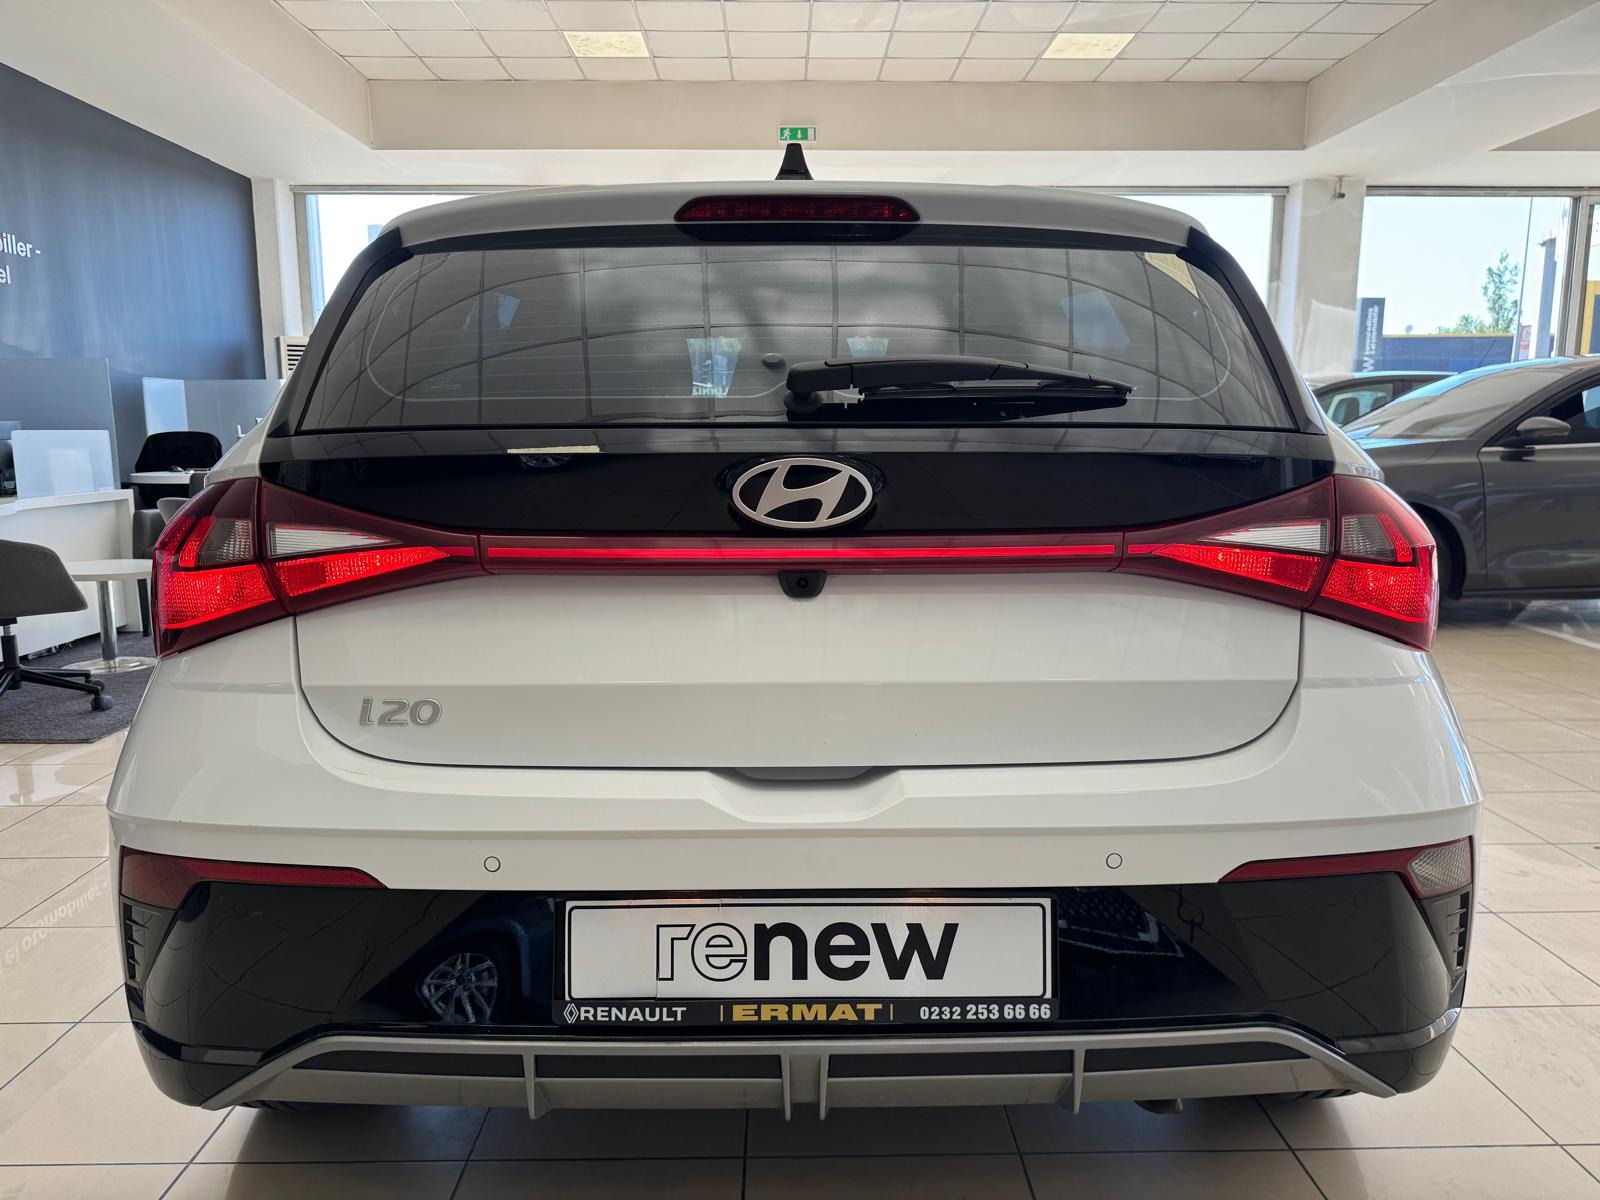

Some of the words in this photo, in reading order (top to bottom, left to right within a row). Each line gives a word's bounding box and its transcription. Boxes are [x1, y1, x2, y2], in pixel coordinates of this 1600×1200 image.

[359, 697, 443, 727] i20
[656, 921, 959, 982] renew
[580, 1006, 687, 1022] RENAULT
[732, 1003, 882, 1022] ERMAT
[920, 1006, 961, 1020] 0232
[966, 1004, 1000, 1020] 253
[1003, 1004, 1026, 1019] 66
[1029, 1003, 1051, 1019] 66
